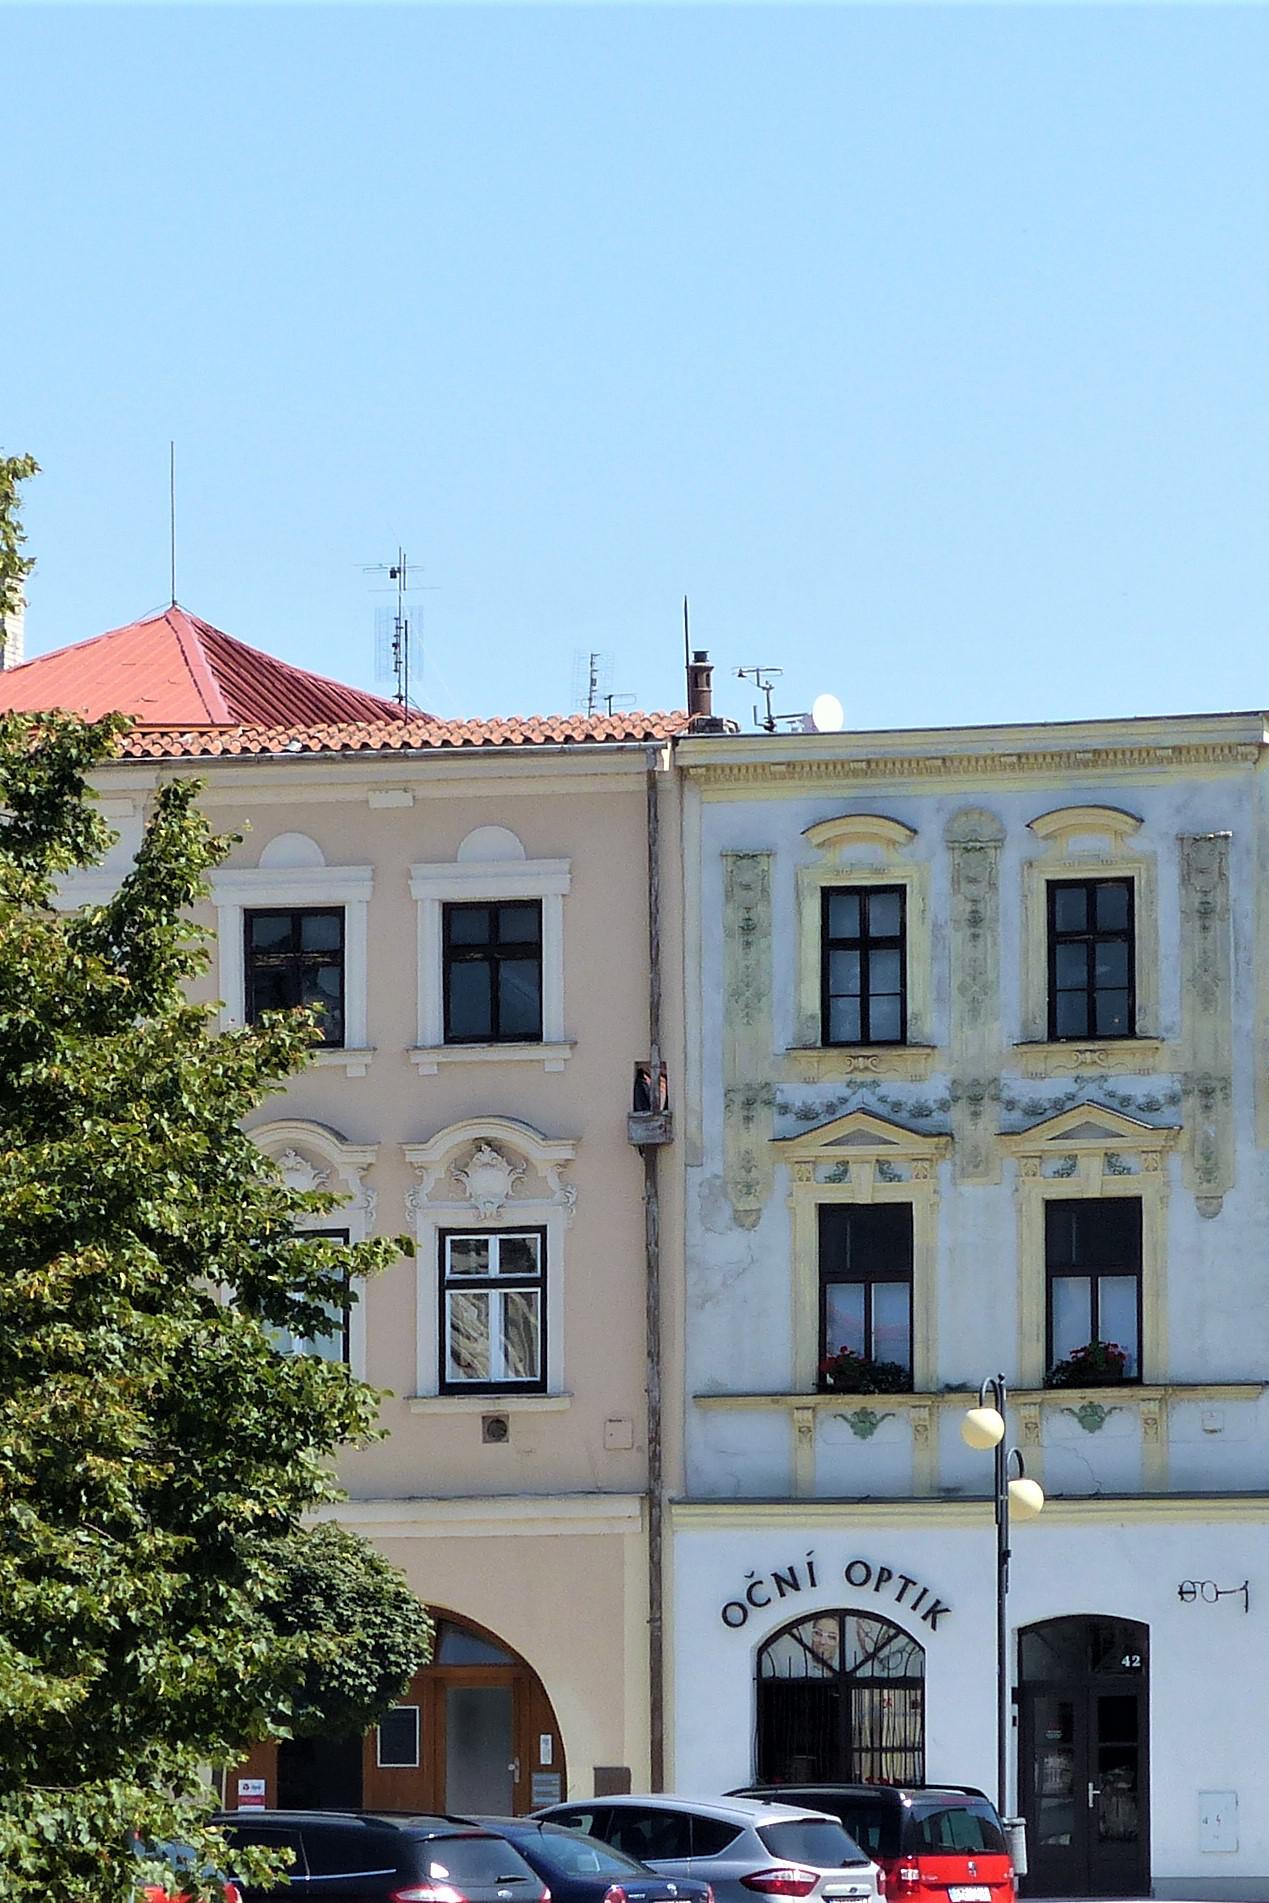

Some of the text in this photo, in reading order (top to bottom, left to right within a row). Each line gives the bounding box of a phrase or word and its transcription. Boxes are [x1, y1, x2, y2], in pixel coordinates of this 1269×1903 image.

[721, 1550, 952, 1632] OČNÍ OPTIK
[1121, 1654, 1141, 1668] 42
